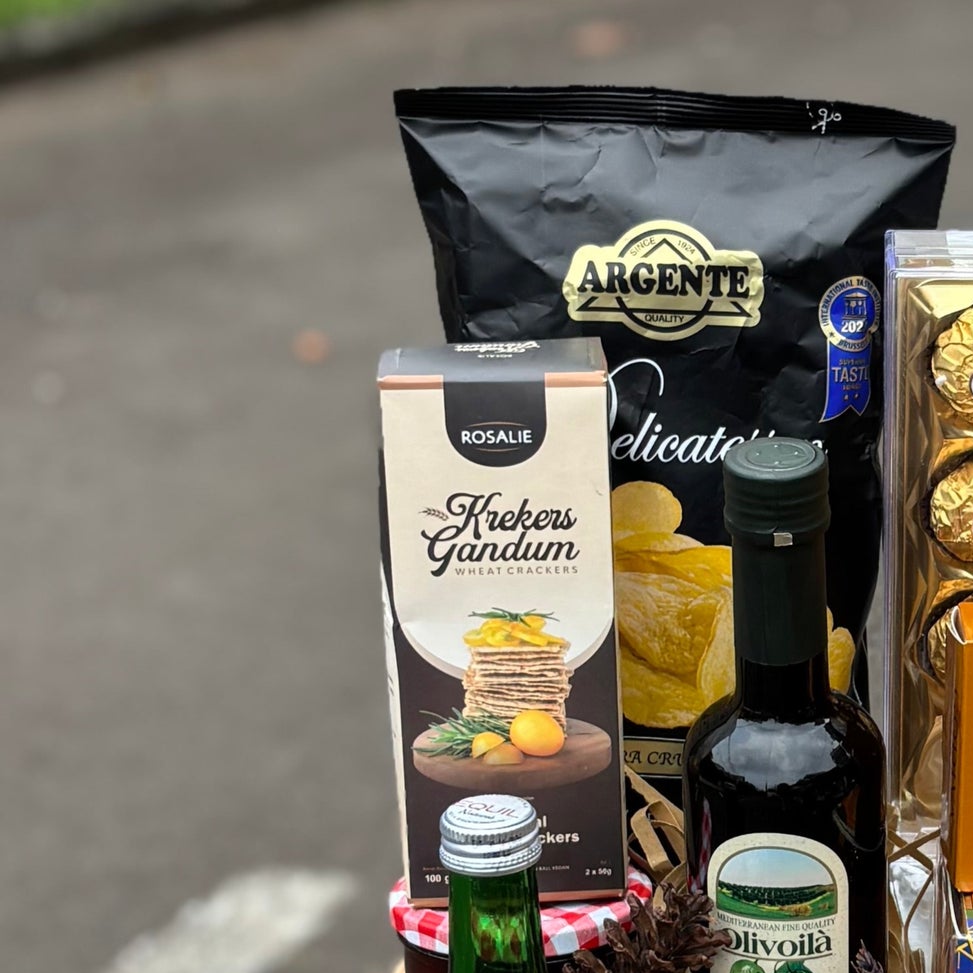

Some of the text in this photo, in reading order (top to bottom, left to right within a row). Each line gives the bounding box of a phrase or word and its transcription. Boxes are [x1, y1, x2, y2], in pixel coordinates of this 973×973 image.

[630, 237, 697, 257] SINCE 1924
[577, 260, 750, 299] ARGENTE
[644, 313, 685, 323] QUALITY
[461, 429, 533, 445] ROSALIE
[446, 492, 578, 540] Krekers
[421, 525, 580, 577] Gandum
[454, 565, 578, 576] WHEAT CRACKERS
[425, 874, 442, 883] 100
[717, 911, 837, 931] MEDITERRANEAN FINE QUALITY
